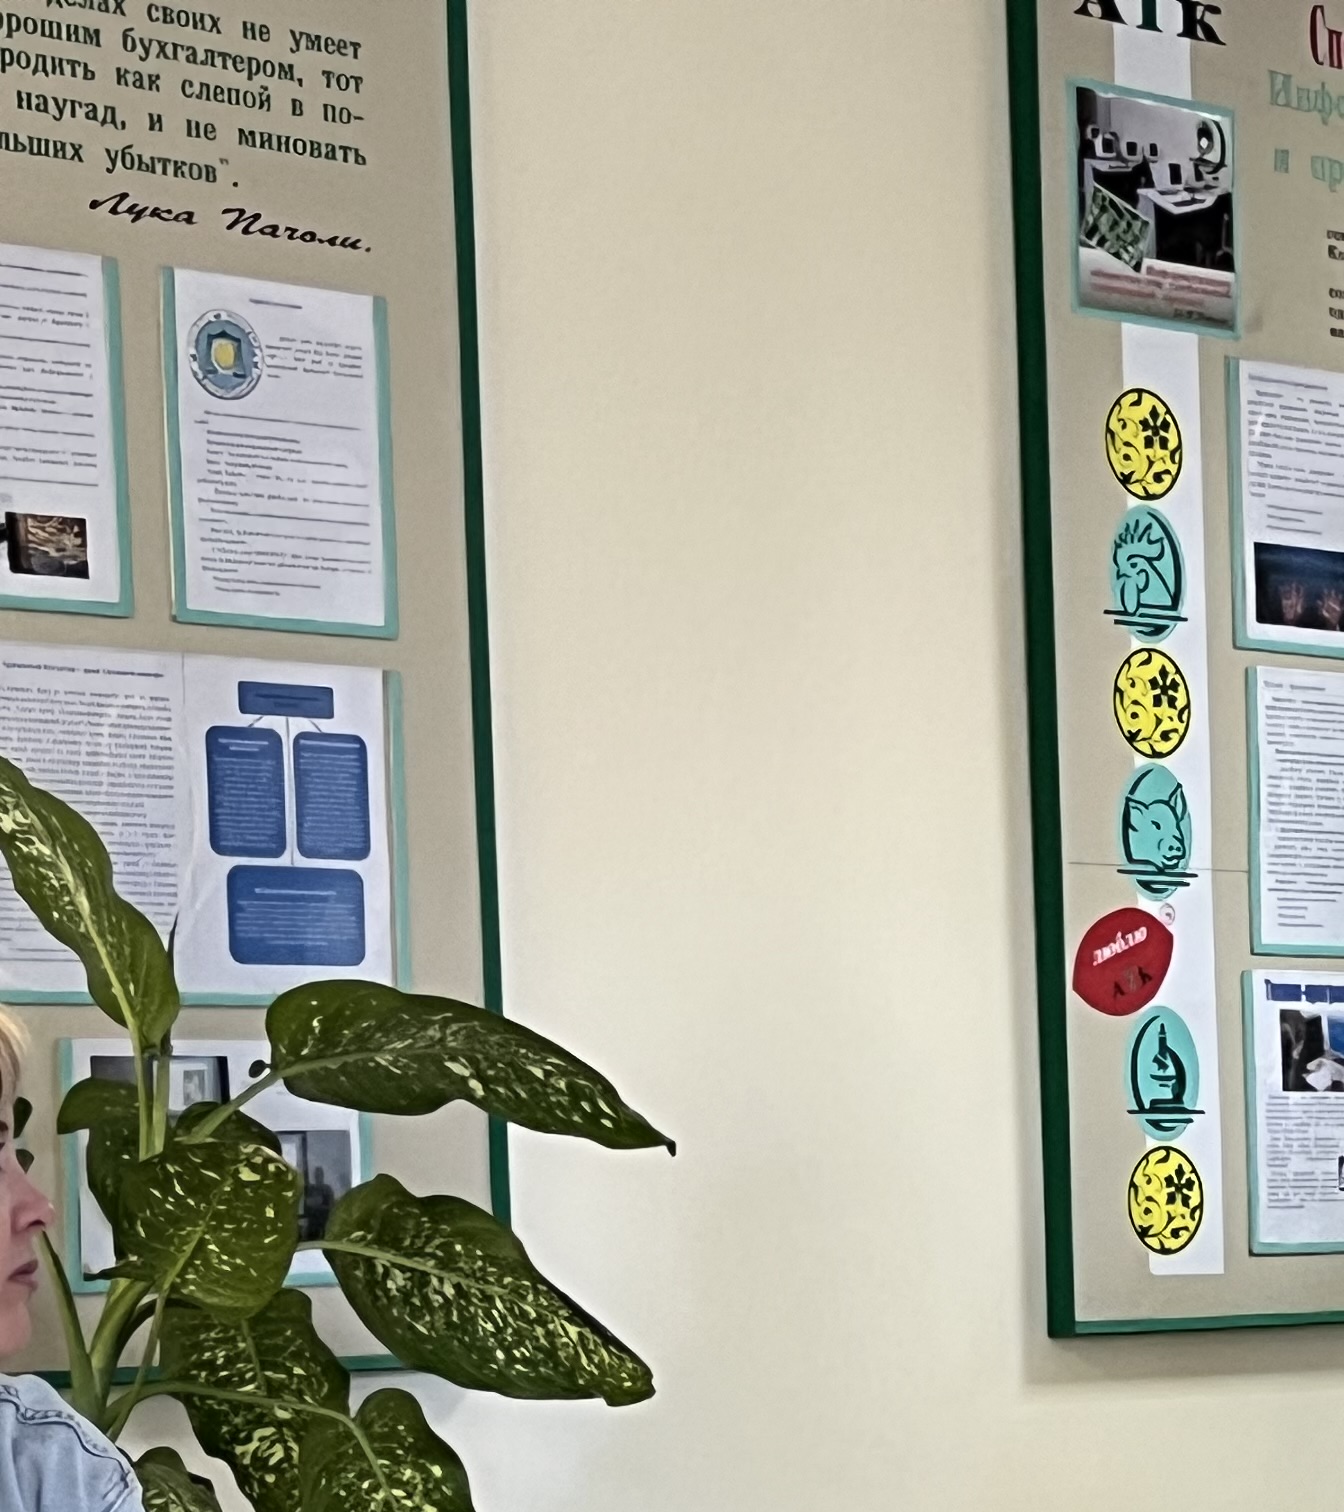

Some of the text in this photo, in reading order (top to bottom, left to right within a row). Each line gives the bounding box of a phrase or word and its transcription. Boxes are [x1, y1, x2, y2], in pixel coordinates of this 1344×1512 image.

[0, 12, 363, 93] рошим бухгалтером, тот
[146, 3, 222, 34] своих
[242, 20, 271, 42] не
[289, 29, 362, 59] умеет
[116, 67, 161, 92] как
[181, 79, 271, 112] слепой
[291, 98, 304, 116] в
[323, 103, 365, 124] по-
[16, 90, 367, 165] наугад, и не миновать
[89, 192, 198, 223] Лука
